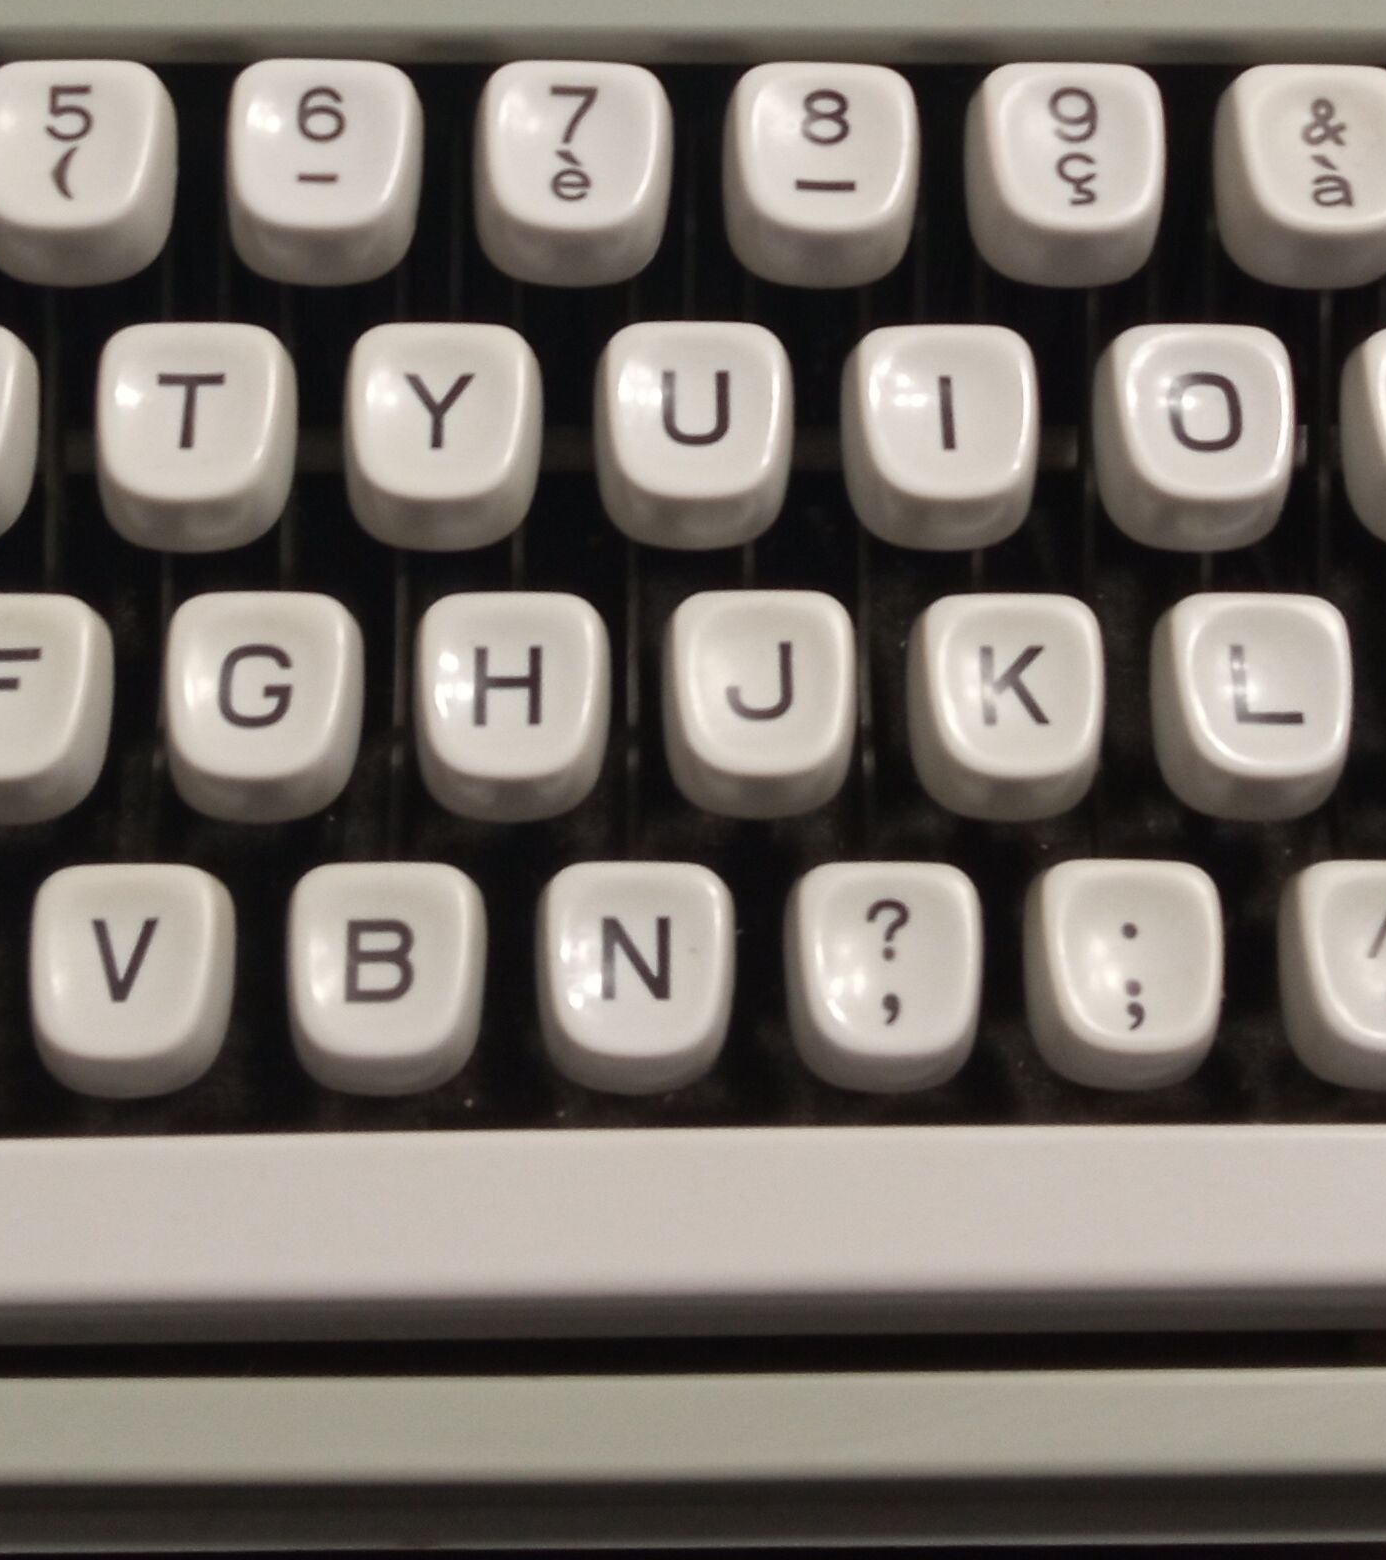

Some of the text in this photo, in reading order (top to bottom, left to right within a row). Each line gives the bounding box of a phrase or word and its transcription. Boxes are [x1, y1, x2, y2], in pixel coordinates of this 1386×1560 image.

[44, 85, 94, 141] 5
[296, 86, 345, 143] 6
[550, 86, 599, 144] 7
[801, 89, 850, 146] 8
[1047, 86, 1099, 144] 9
[51, 146, 79, 201] (
[550, 150, 592, 202] è
[1055, 151, 1098, 205] ç
[1312, 154, 1354, 208] à
[157, 372, 226, 449] T
[404, 373, 475, 450] Y
[661, 370, 731, 446] U
[937, 375, 957, 451] I
[1167, 372, 1242, 452] O
[217, 644, 294, 728] G
[472, 645, 542, 727] H
[725, 641, 794, 721] J
[979, 645, 1051, 726] K
[1229, 644, 1305, 725] L
[91, 918, 159, 1003] V
[344, 919, 415, 1004] B
[601, 915, 671, 1001] N
[865, 899, 910, 962] ?
